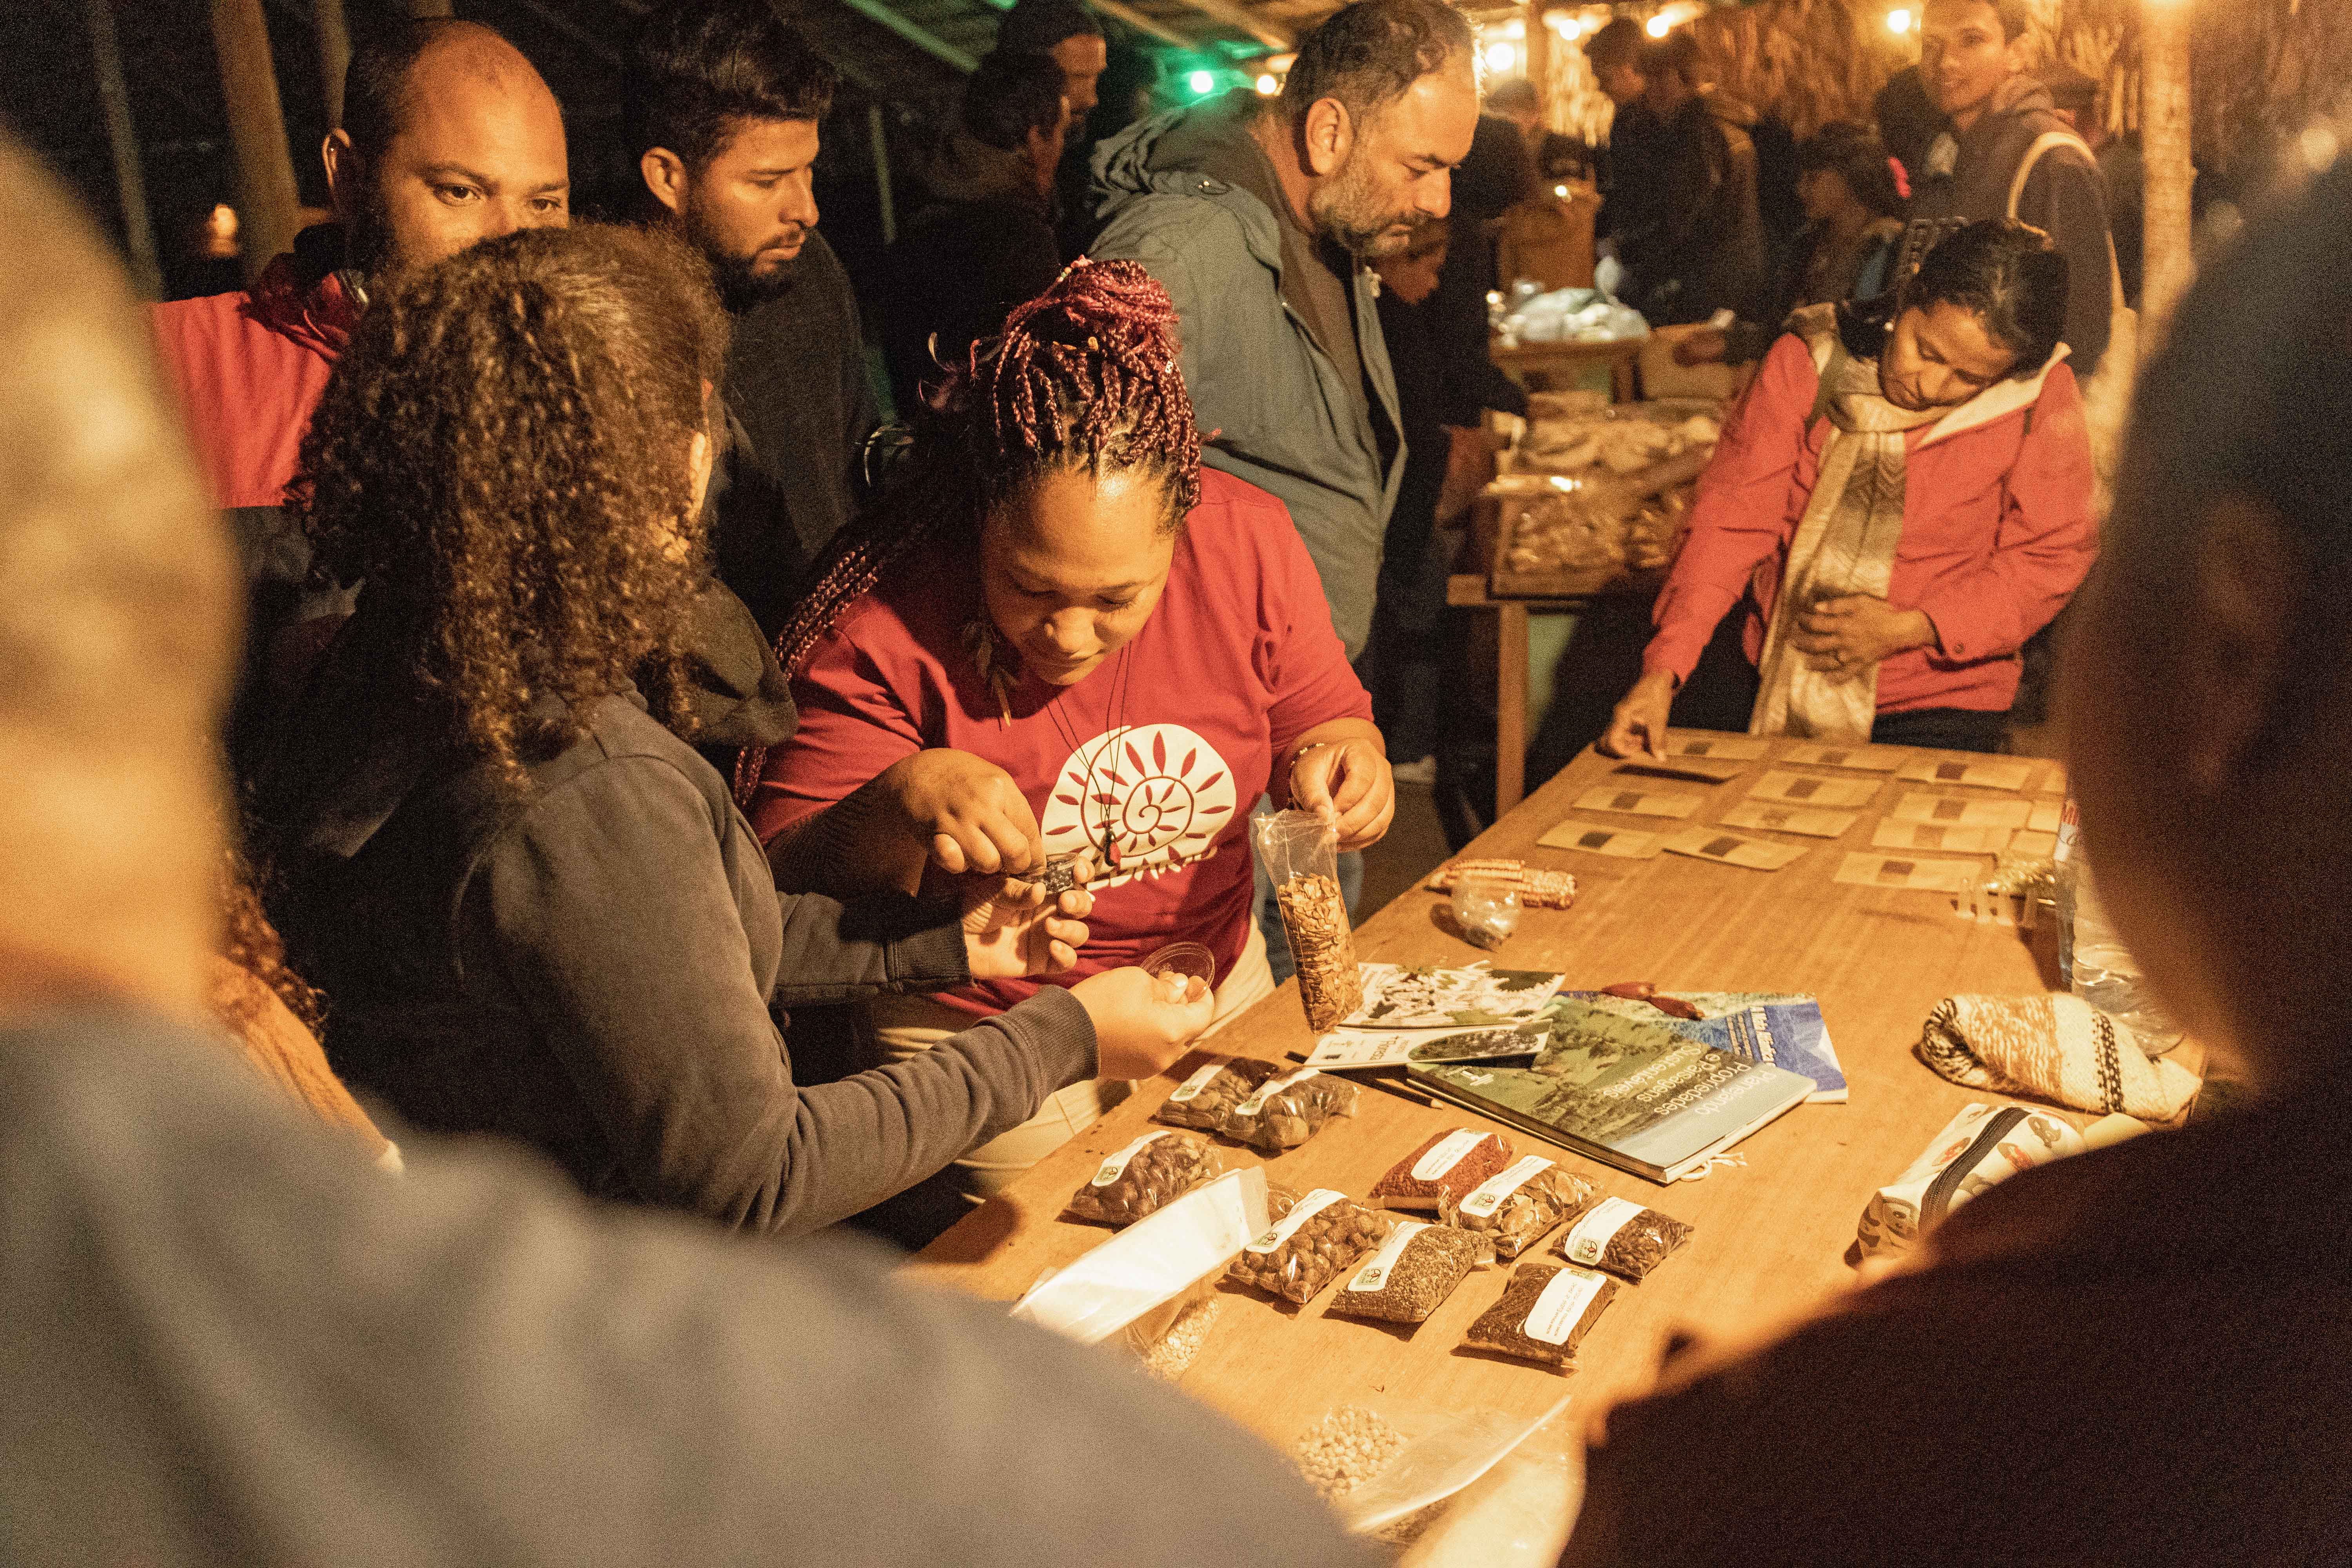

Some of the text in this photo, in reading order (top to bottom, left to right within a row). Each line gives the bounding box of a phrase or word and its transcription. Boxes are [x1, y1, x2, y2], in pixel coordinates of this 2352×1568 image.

[1751, 1012, 1768, 1030] Mata
[1603, 1045, 1701, 1098] Sustentáveis
[1636, 1053, 1720, 1102] e Paisagens
[1654, 1061, 1752, 1115] Propriedades
[1695, 1070, 1777, 1115] Planejando
